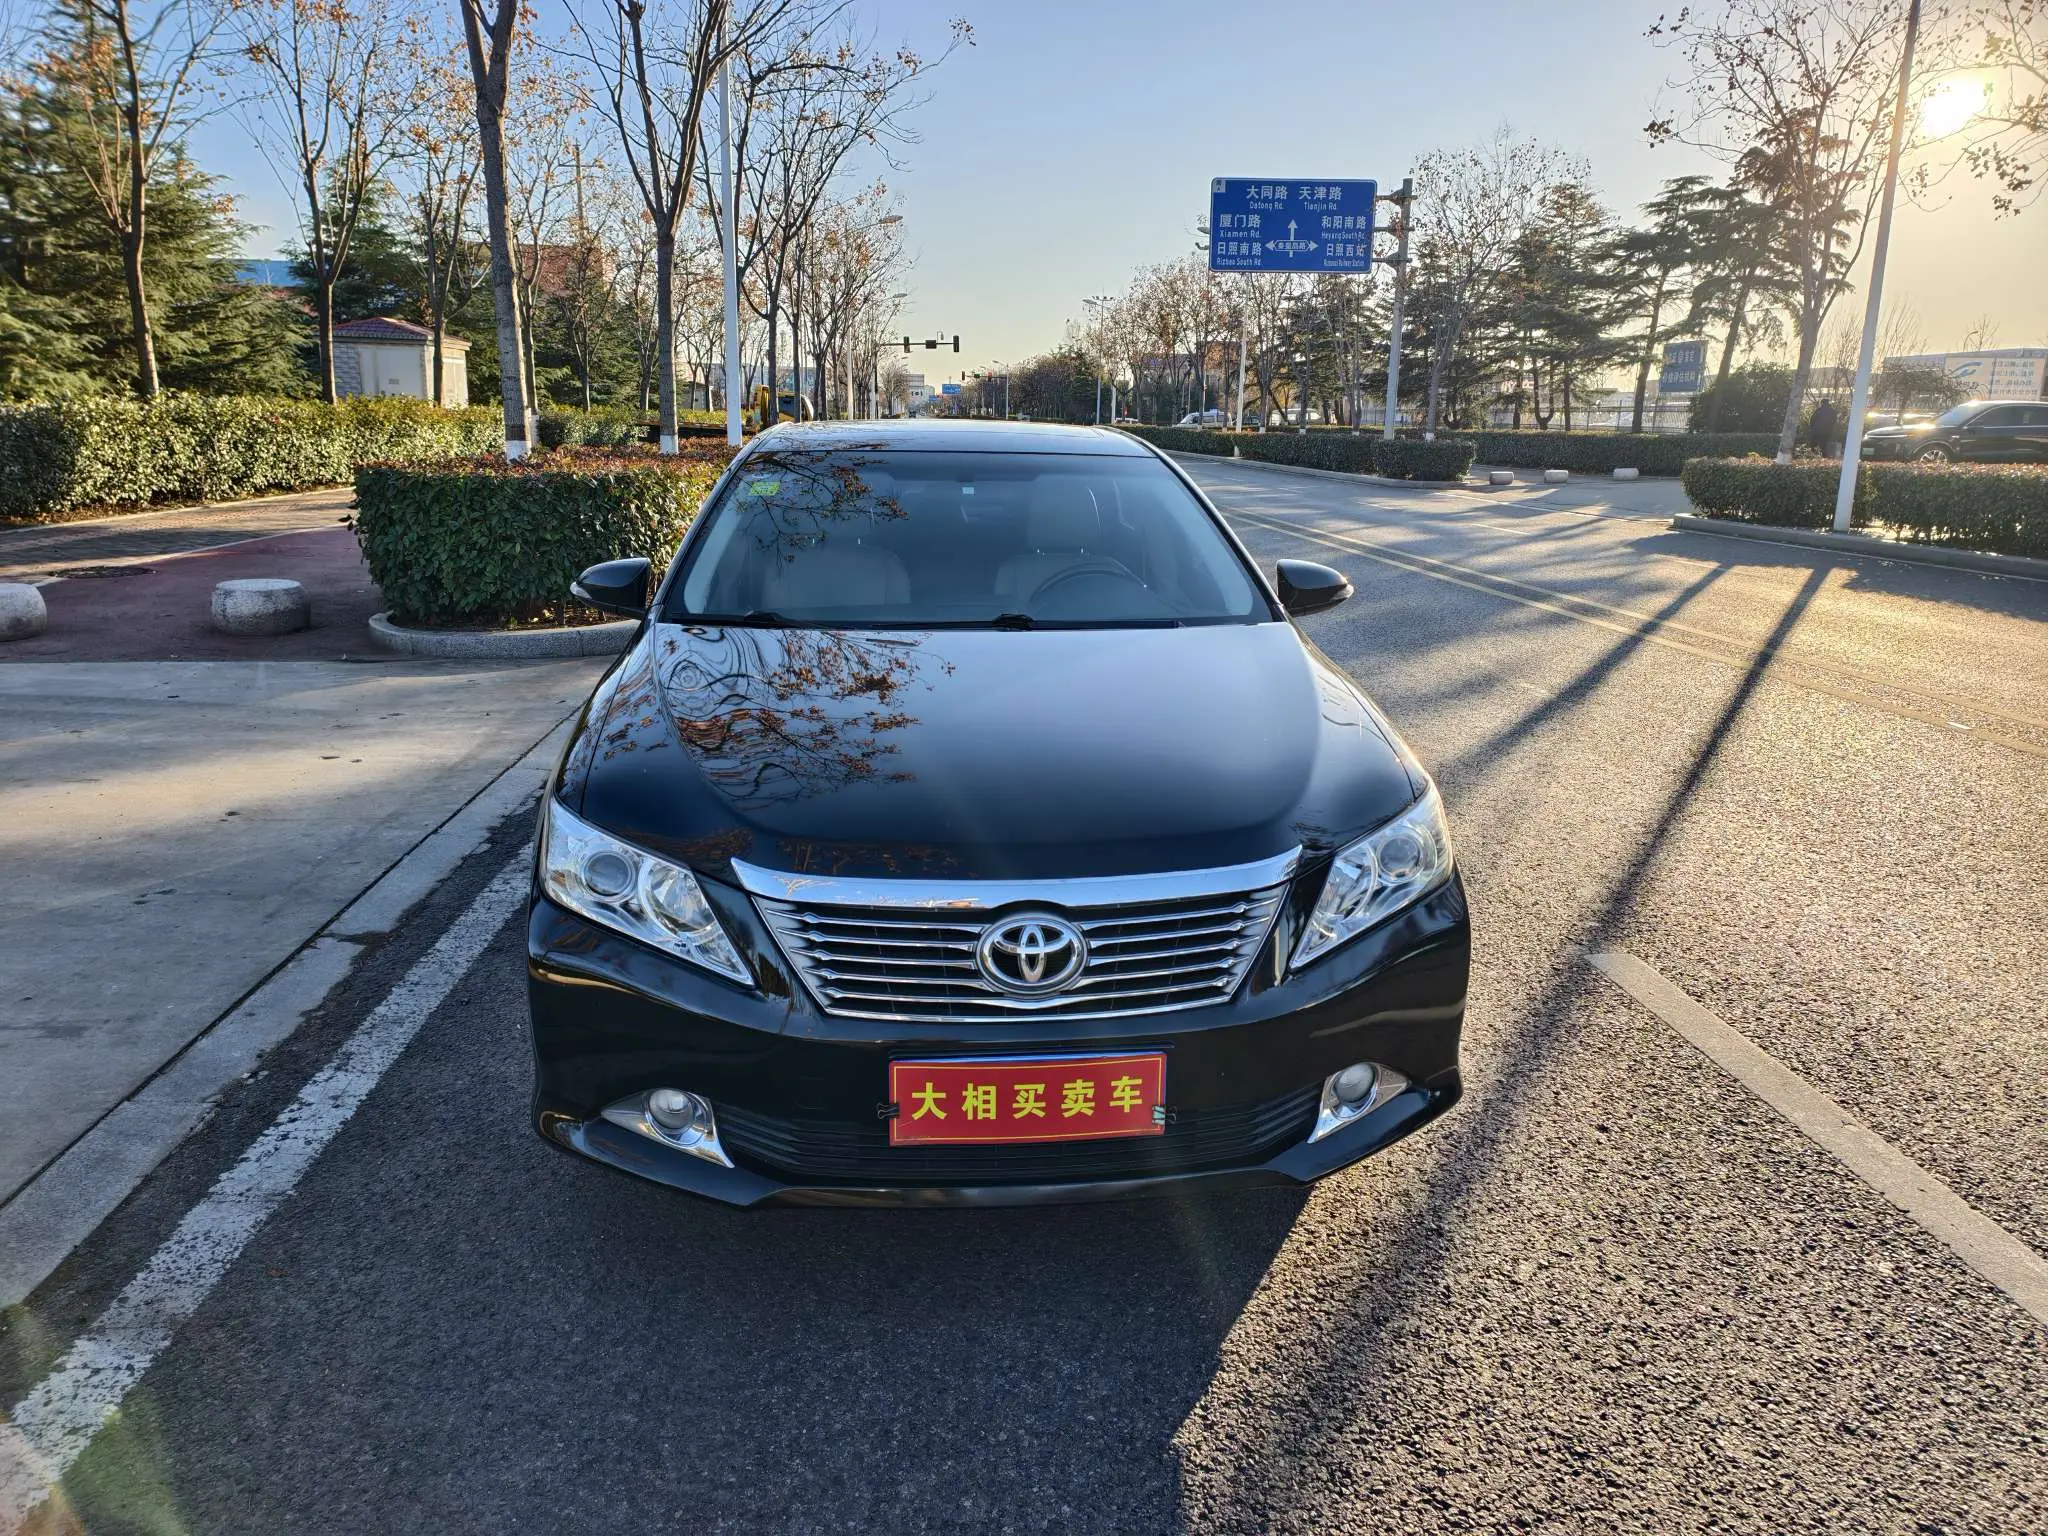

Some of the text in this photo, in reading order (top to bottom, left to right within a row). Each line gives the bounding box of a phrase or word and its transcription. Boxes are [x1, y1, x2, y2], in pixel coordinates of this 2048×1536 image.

[1246, 185, 1288, 200] 大同路
[1299, 186, 1342, 201] 天津路
[1249, 201, 1273, 212] Datong
[1304, 202, 1327, 212] Tianjin
[1219, 213, 1262, 228] 厦门路
[1321, 215, 1367, 230] 和阳南路
[1219, 230, 1248, 238] Xiamen
[1217, 241, 1262, 256] 日照南路
[1326, 243, 1367, 257] 日照西站
[1236, 257, 1253, 266] South
[911, 1074, 1143, 1121] 大相买卖车
